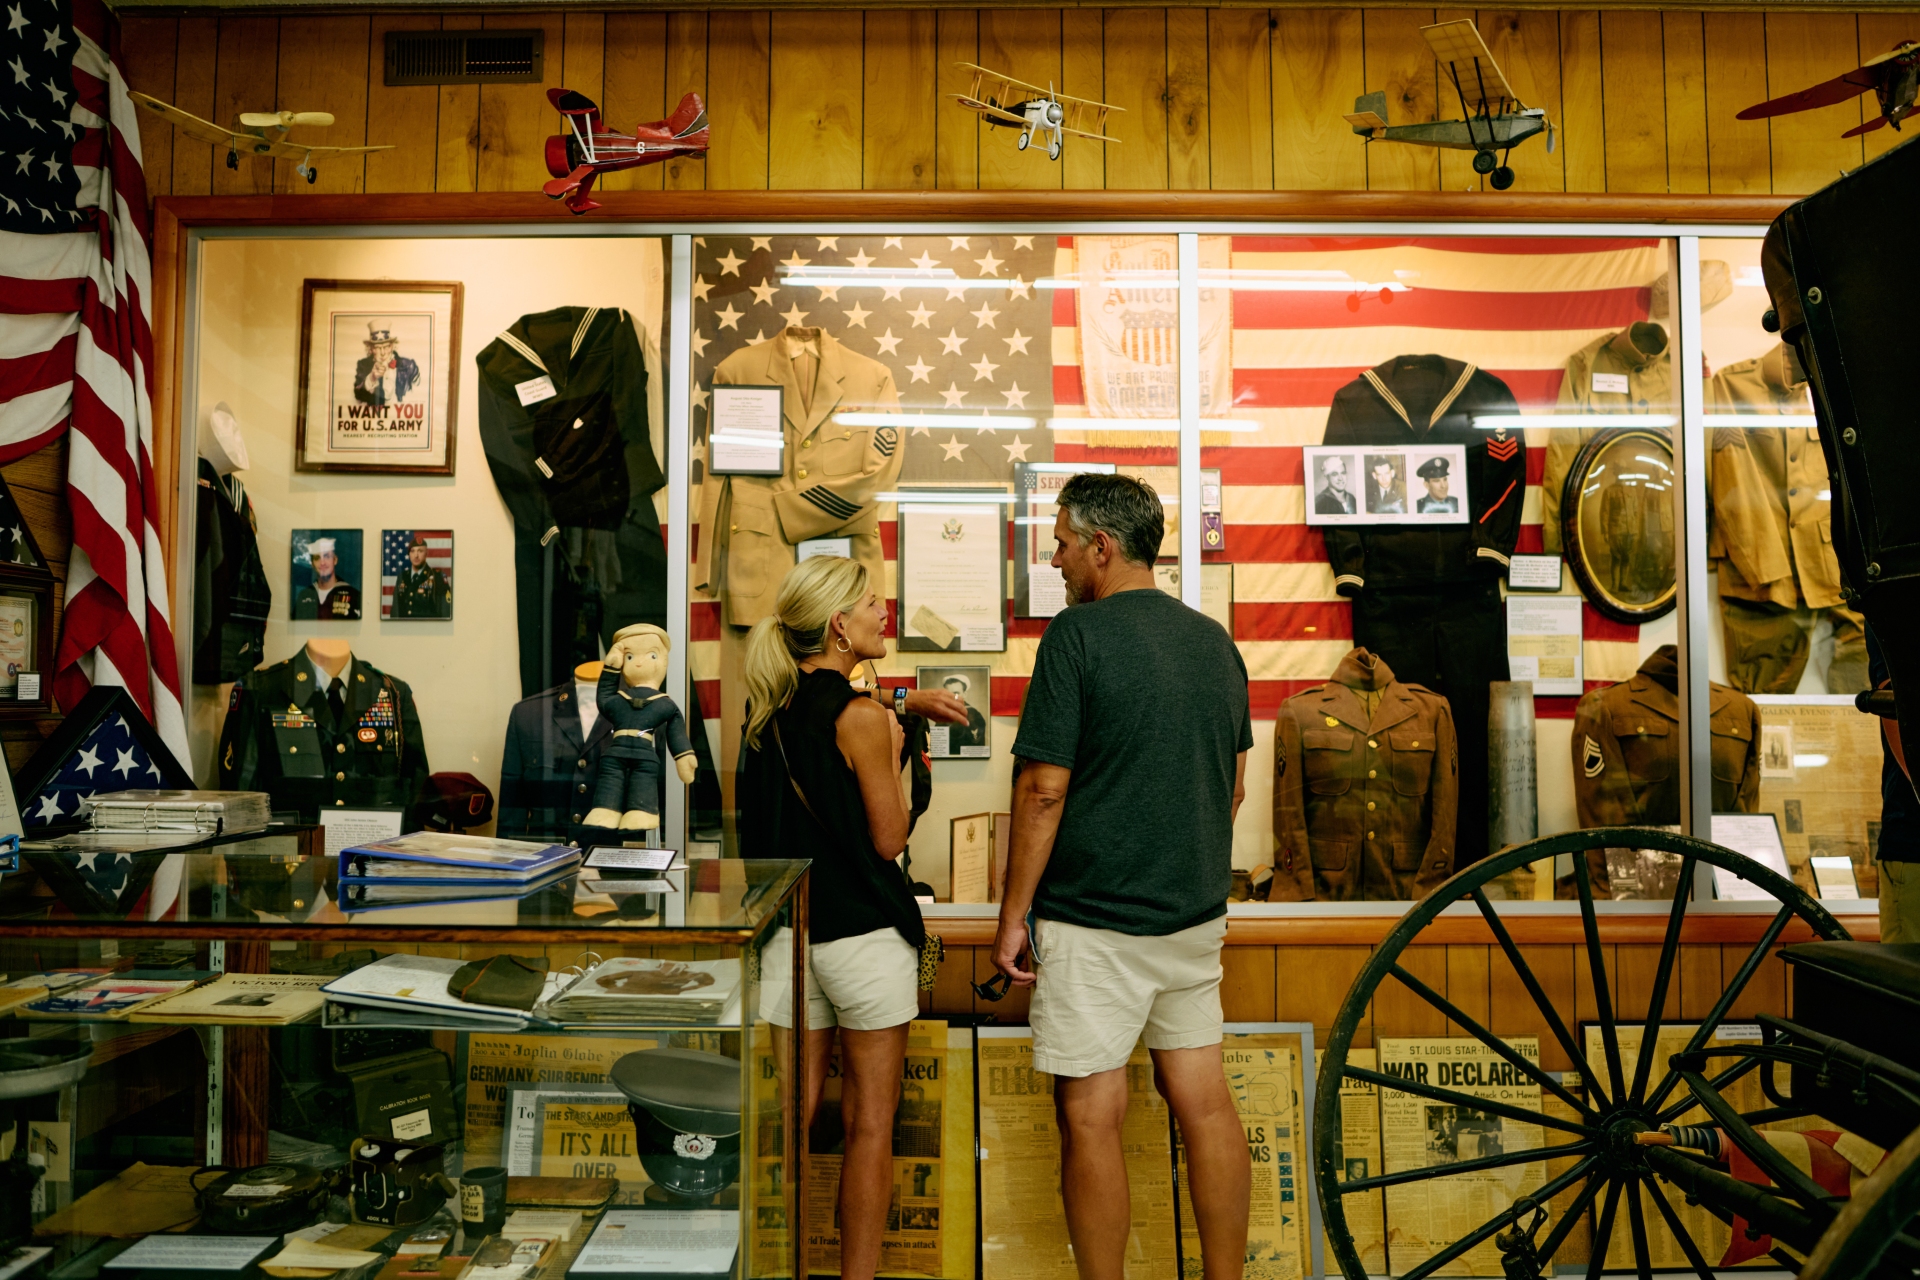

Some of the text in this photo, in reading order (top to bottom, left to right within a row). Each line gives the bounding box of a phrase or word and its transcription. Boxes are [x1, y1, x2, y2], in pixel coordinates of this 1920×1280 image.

[637, 142, 645, 154] 6
[1107, 371, 1121, 385] WE
[338, 404, 423, 418] I WANT YOU
[338, 420, 358, 431] FOR
[513, 1044, 603, 1062] Joplin Globe
[1222, 1051, 1253, 1063] lobe
[1409, 1046, 1422, 1055] ST.
[1425, 1046, 1451, 1055] LOUIS
[470, 1065, 534, 1083] GERMANY
[1383, 1062, 1429, 1085] WAR
[1383, 1090, 1541, 1099] 3,000 Attack On Hawaii
[545, 1111, 562, 1120] THE
[594, 1112, 613, 1121] AND
[560, 1132, 631, 1157] IT'S ALL
[573, 1162, 616, 1179] OVER
[818, 1236, 840, 1246] Trade
[903, 1240, 911, 1248] in
[912, 1240, 937, 1249] attack
